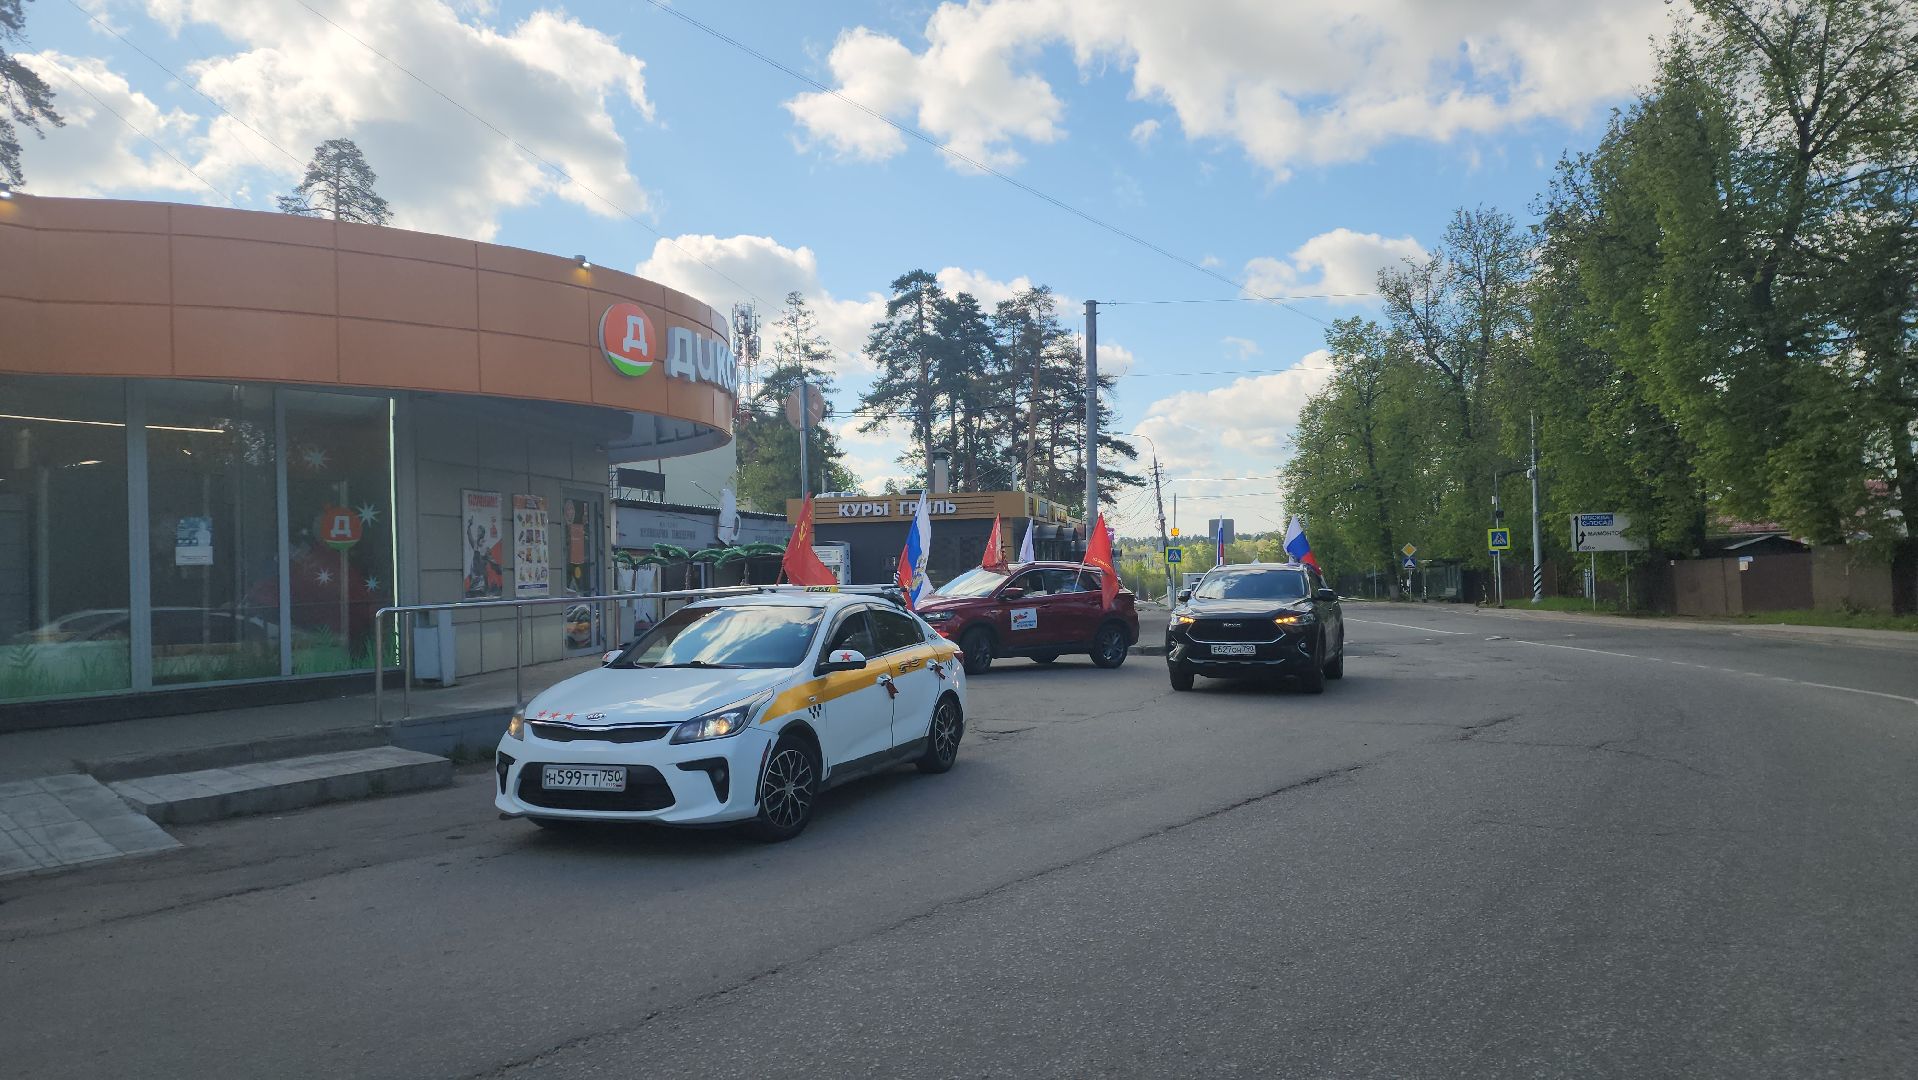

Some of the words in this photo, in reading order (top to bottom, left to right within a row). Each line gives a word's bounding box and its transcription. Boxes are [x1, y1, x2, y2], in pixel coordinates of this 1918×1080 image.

[623, 315, 648, 356] Д
[838, 502, 889, 517] КУРЫ
[331, 515, 352, 537] Д
